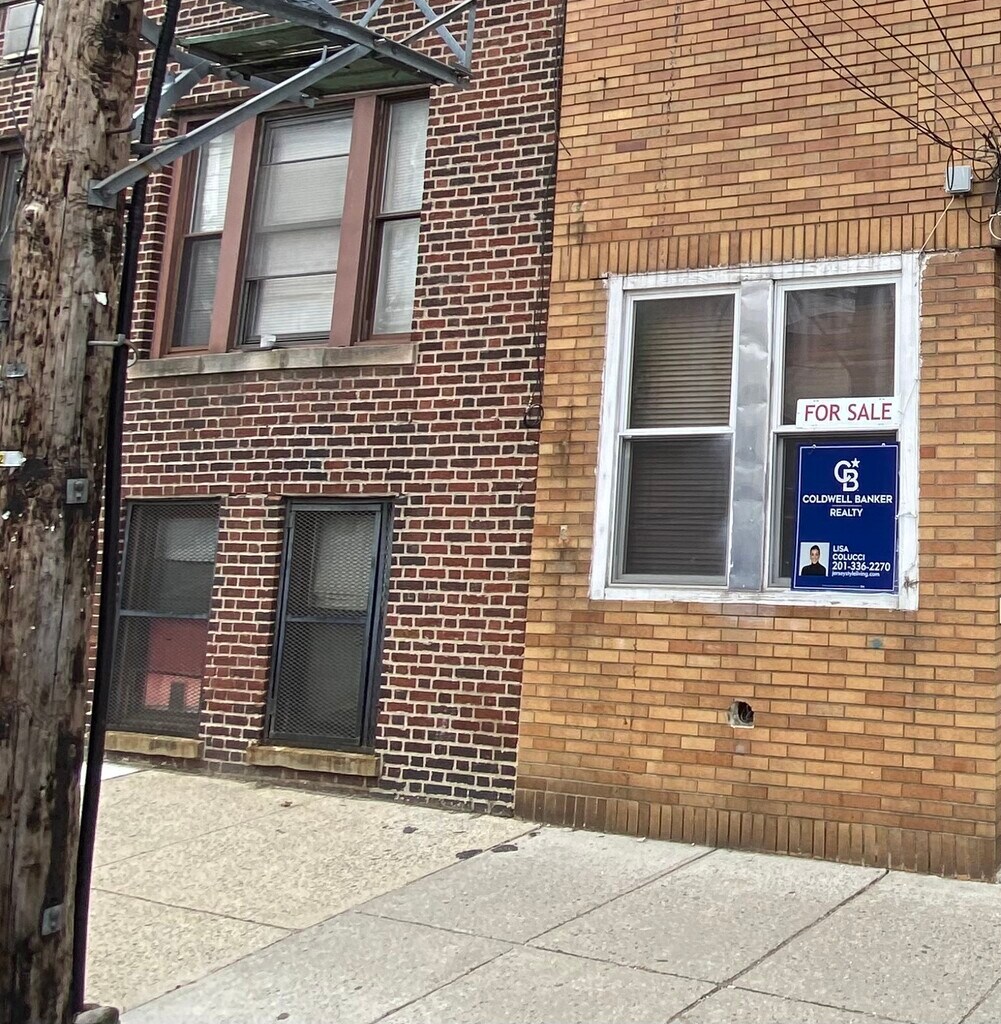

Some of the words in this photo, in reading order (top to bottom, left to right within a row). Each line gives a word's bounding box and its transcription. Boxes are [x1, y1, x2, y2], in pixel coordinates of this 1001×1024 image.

[804, 404, 841, 422] FOR
[847, 402, 893, 421] SALE
[802, 494, 853, 504] COLDWELL
[854, 494, 893, 504] BANKER
[829, 508, 864, 517] REALTY
[832, 545, 850, 553] LISA
[832, 553, 866, 561] COLUCCI
[831, 561, 891, 572] 201-336-2270
